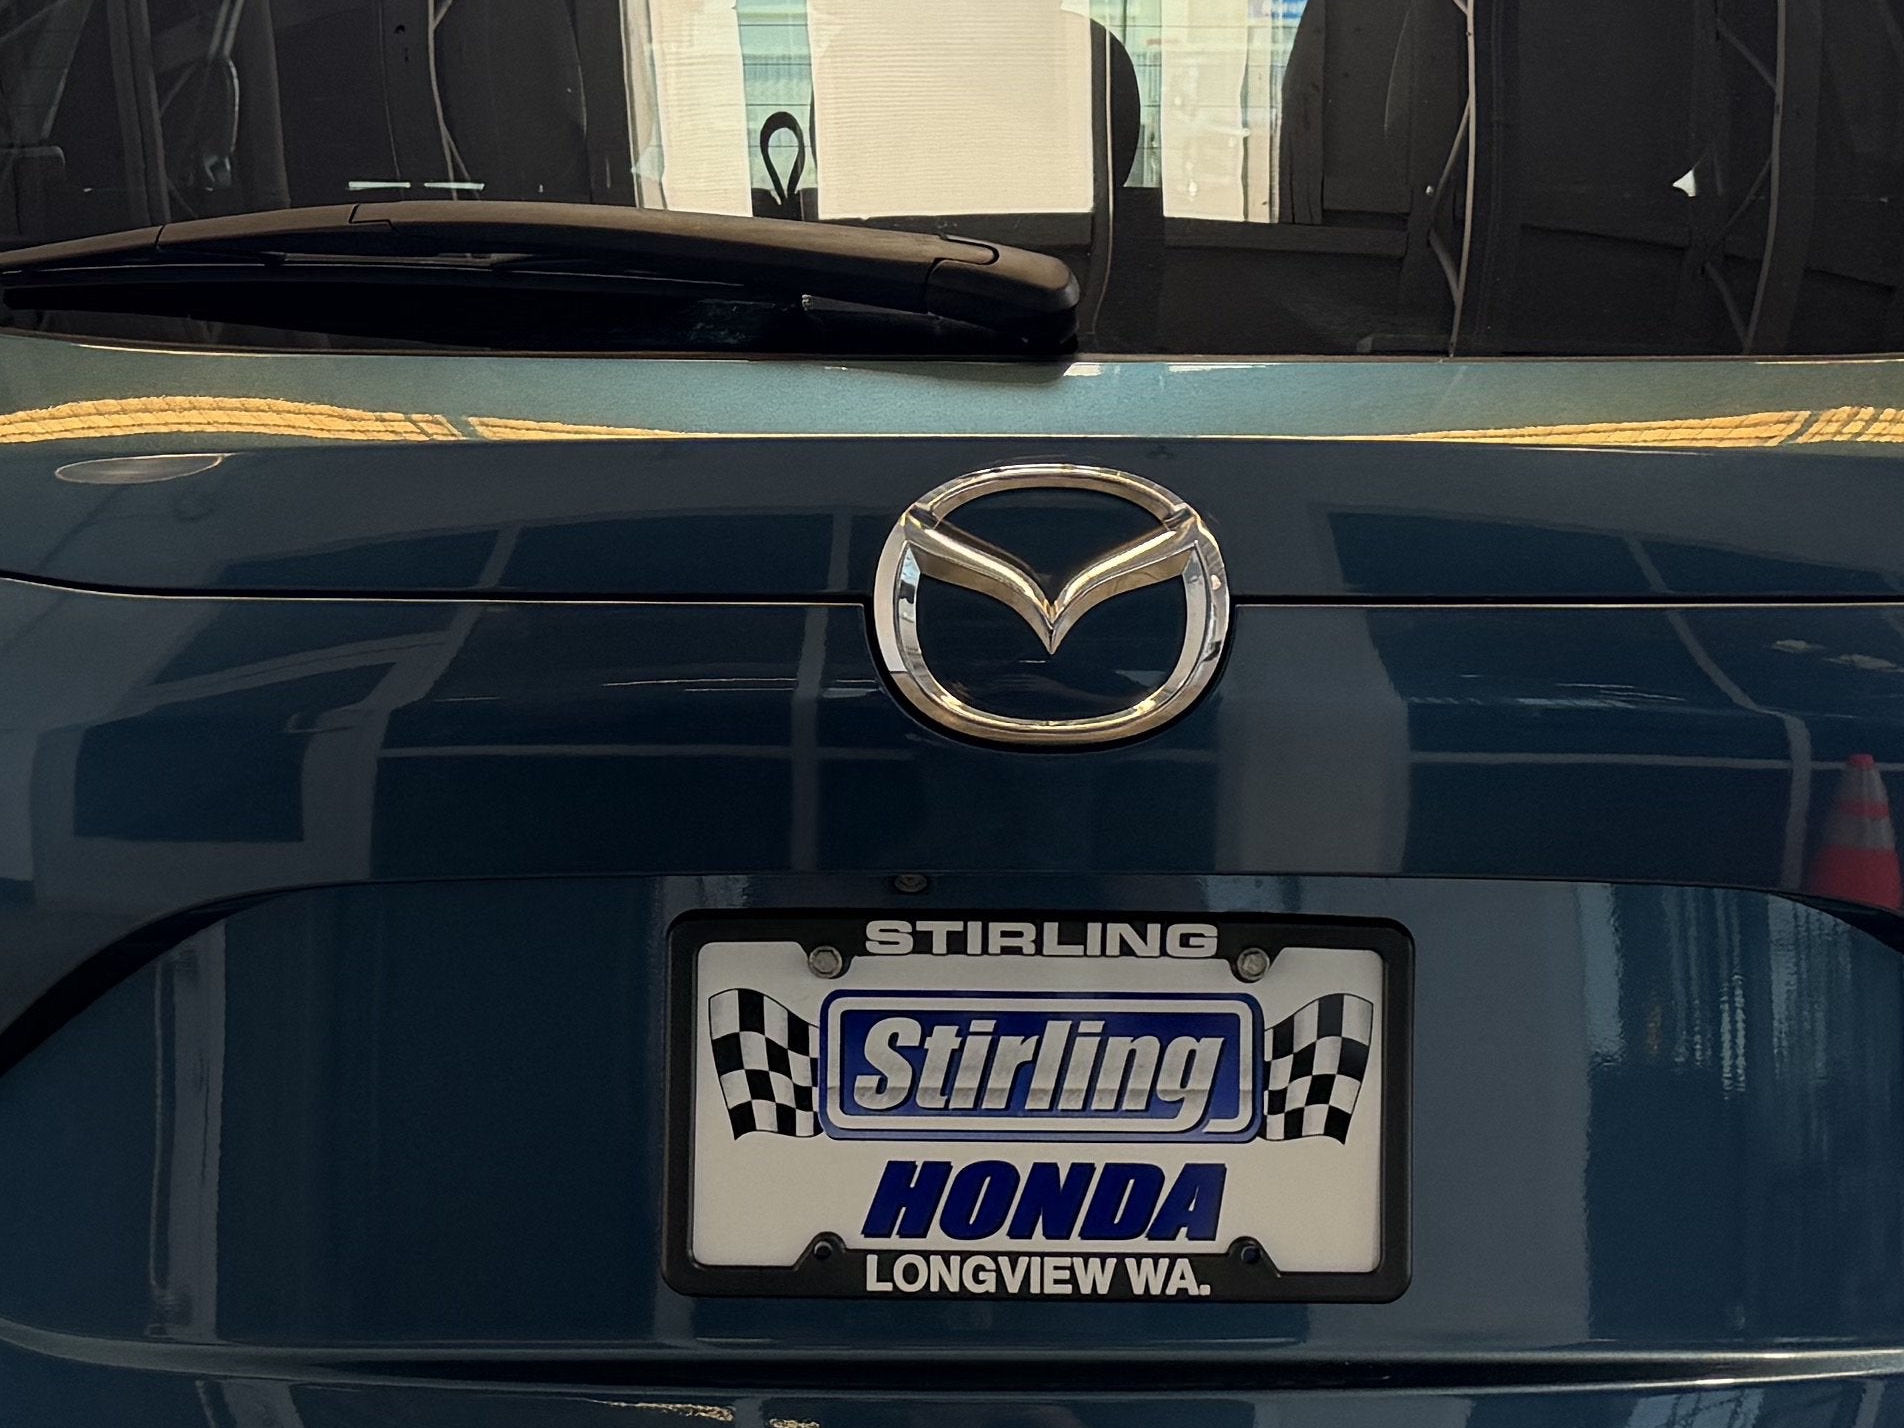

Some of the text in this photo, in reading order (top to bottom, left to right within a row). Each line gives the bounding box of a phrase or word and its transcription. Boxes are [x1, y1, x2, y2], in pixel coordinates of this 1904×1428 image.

[865, 920, 1218, 958] STIRLING
[853, 1017, 1225, 1131] Stirling
[861, 1160, 1227, 1242] HONDA
[865, 1254, 1212, 1296] LONGVIEW WA.
